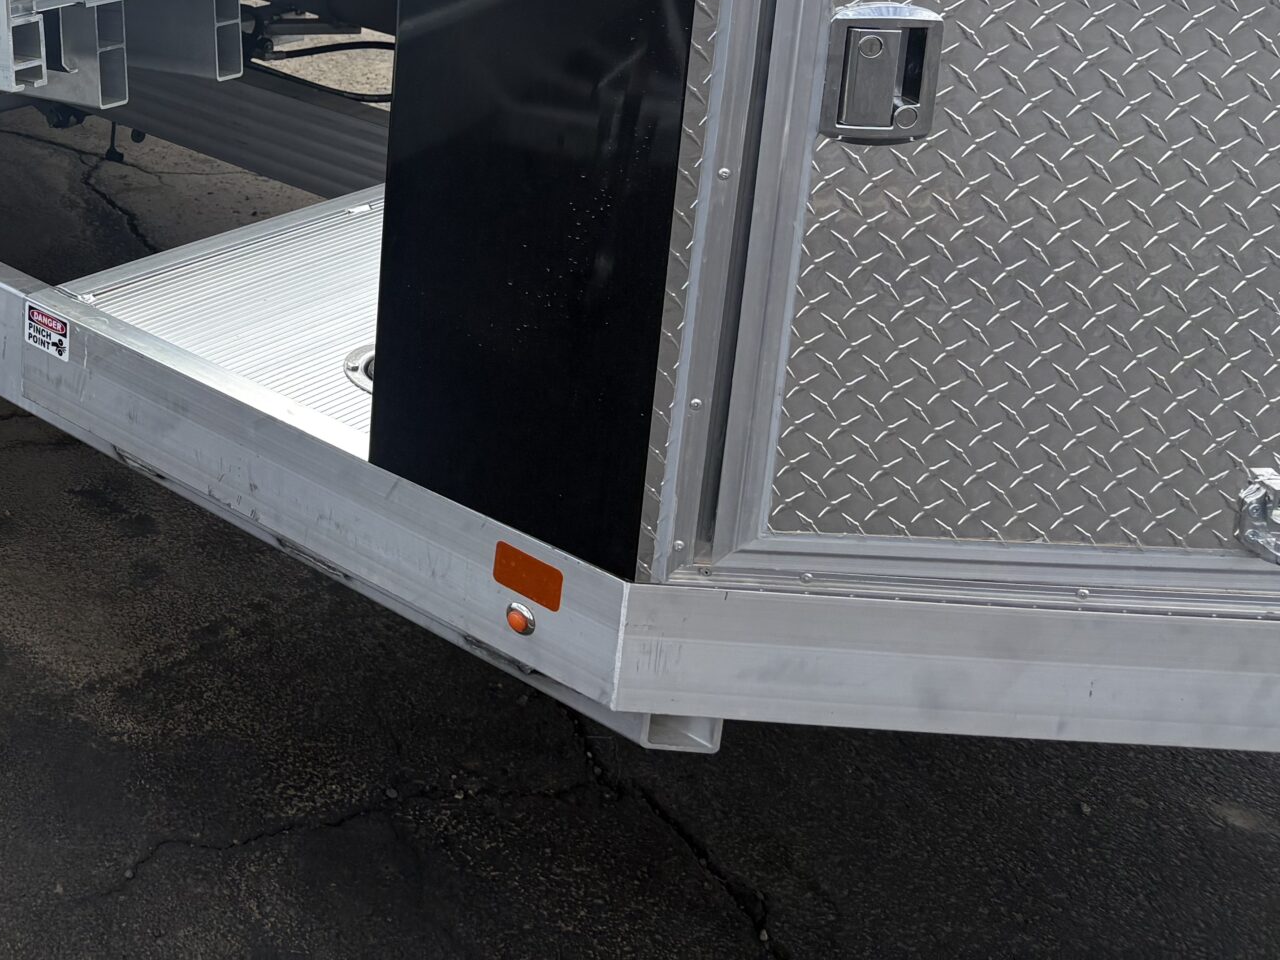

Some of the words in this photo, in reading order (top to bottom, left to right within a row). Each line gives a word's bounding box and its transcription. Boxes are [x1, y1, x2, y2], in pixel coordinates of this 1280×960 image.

[33, 311, 62, 331] DANGER
[28, 322, 52, 341] PINCH
[28, 332, 51, 350] POINT
